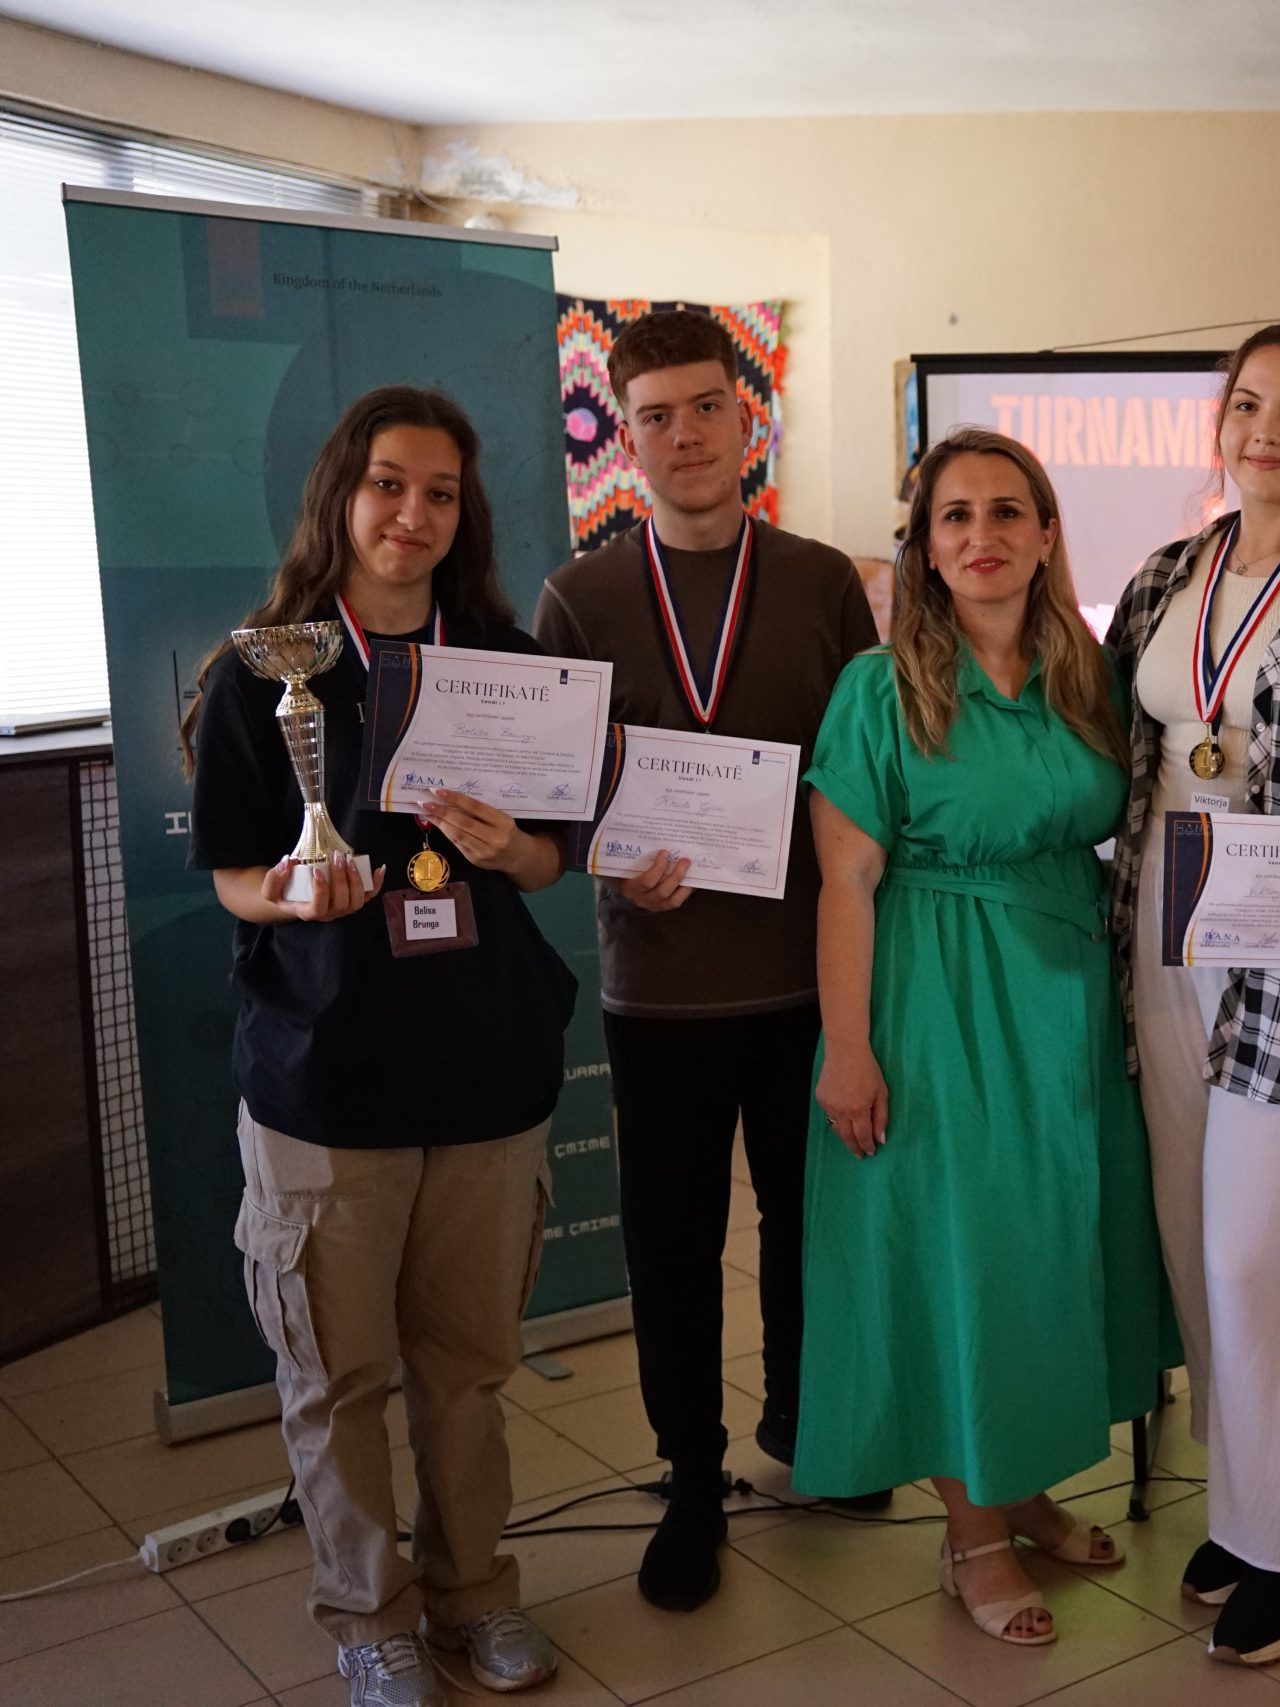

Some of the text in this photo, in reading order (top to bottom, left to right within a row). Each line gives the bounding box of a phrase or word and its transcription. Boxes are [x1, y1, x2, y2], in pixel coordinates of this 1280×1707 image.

[272, 272, 443, 297] Kingdom of the Netherlands
[435, 678, 550, 702] CERTIFIKATË
[637, 756, 743, 781] CERTIFIKATË
[1194, 795, 1227, 808] Viktorja
[414, 906, 436, 915] Belisa
[413, 919, 439, 930] Brunga
[564, 1063, 611, 1081] UARA
[554, 1136, 610, 1159] ÇMIME
